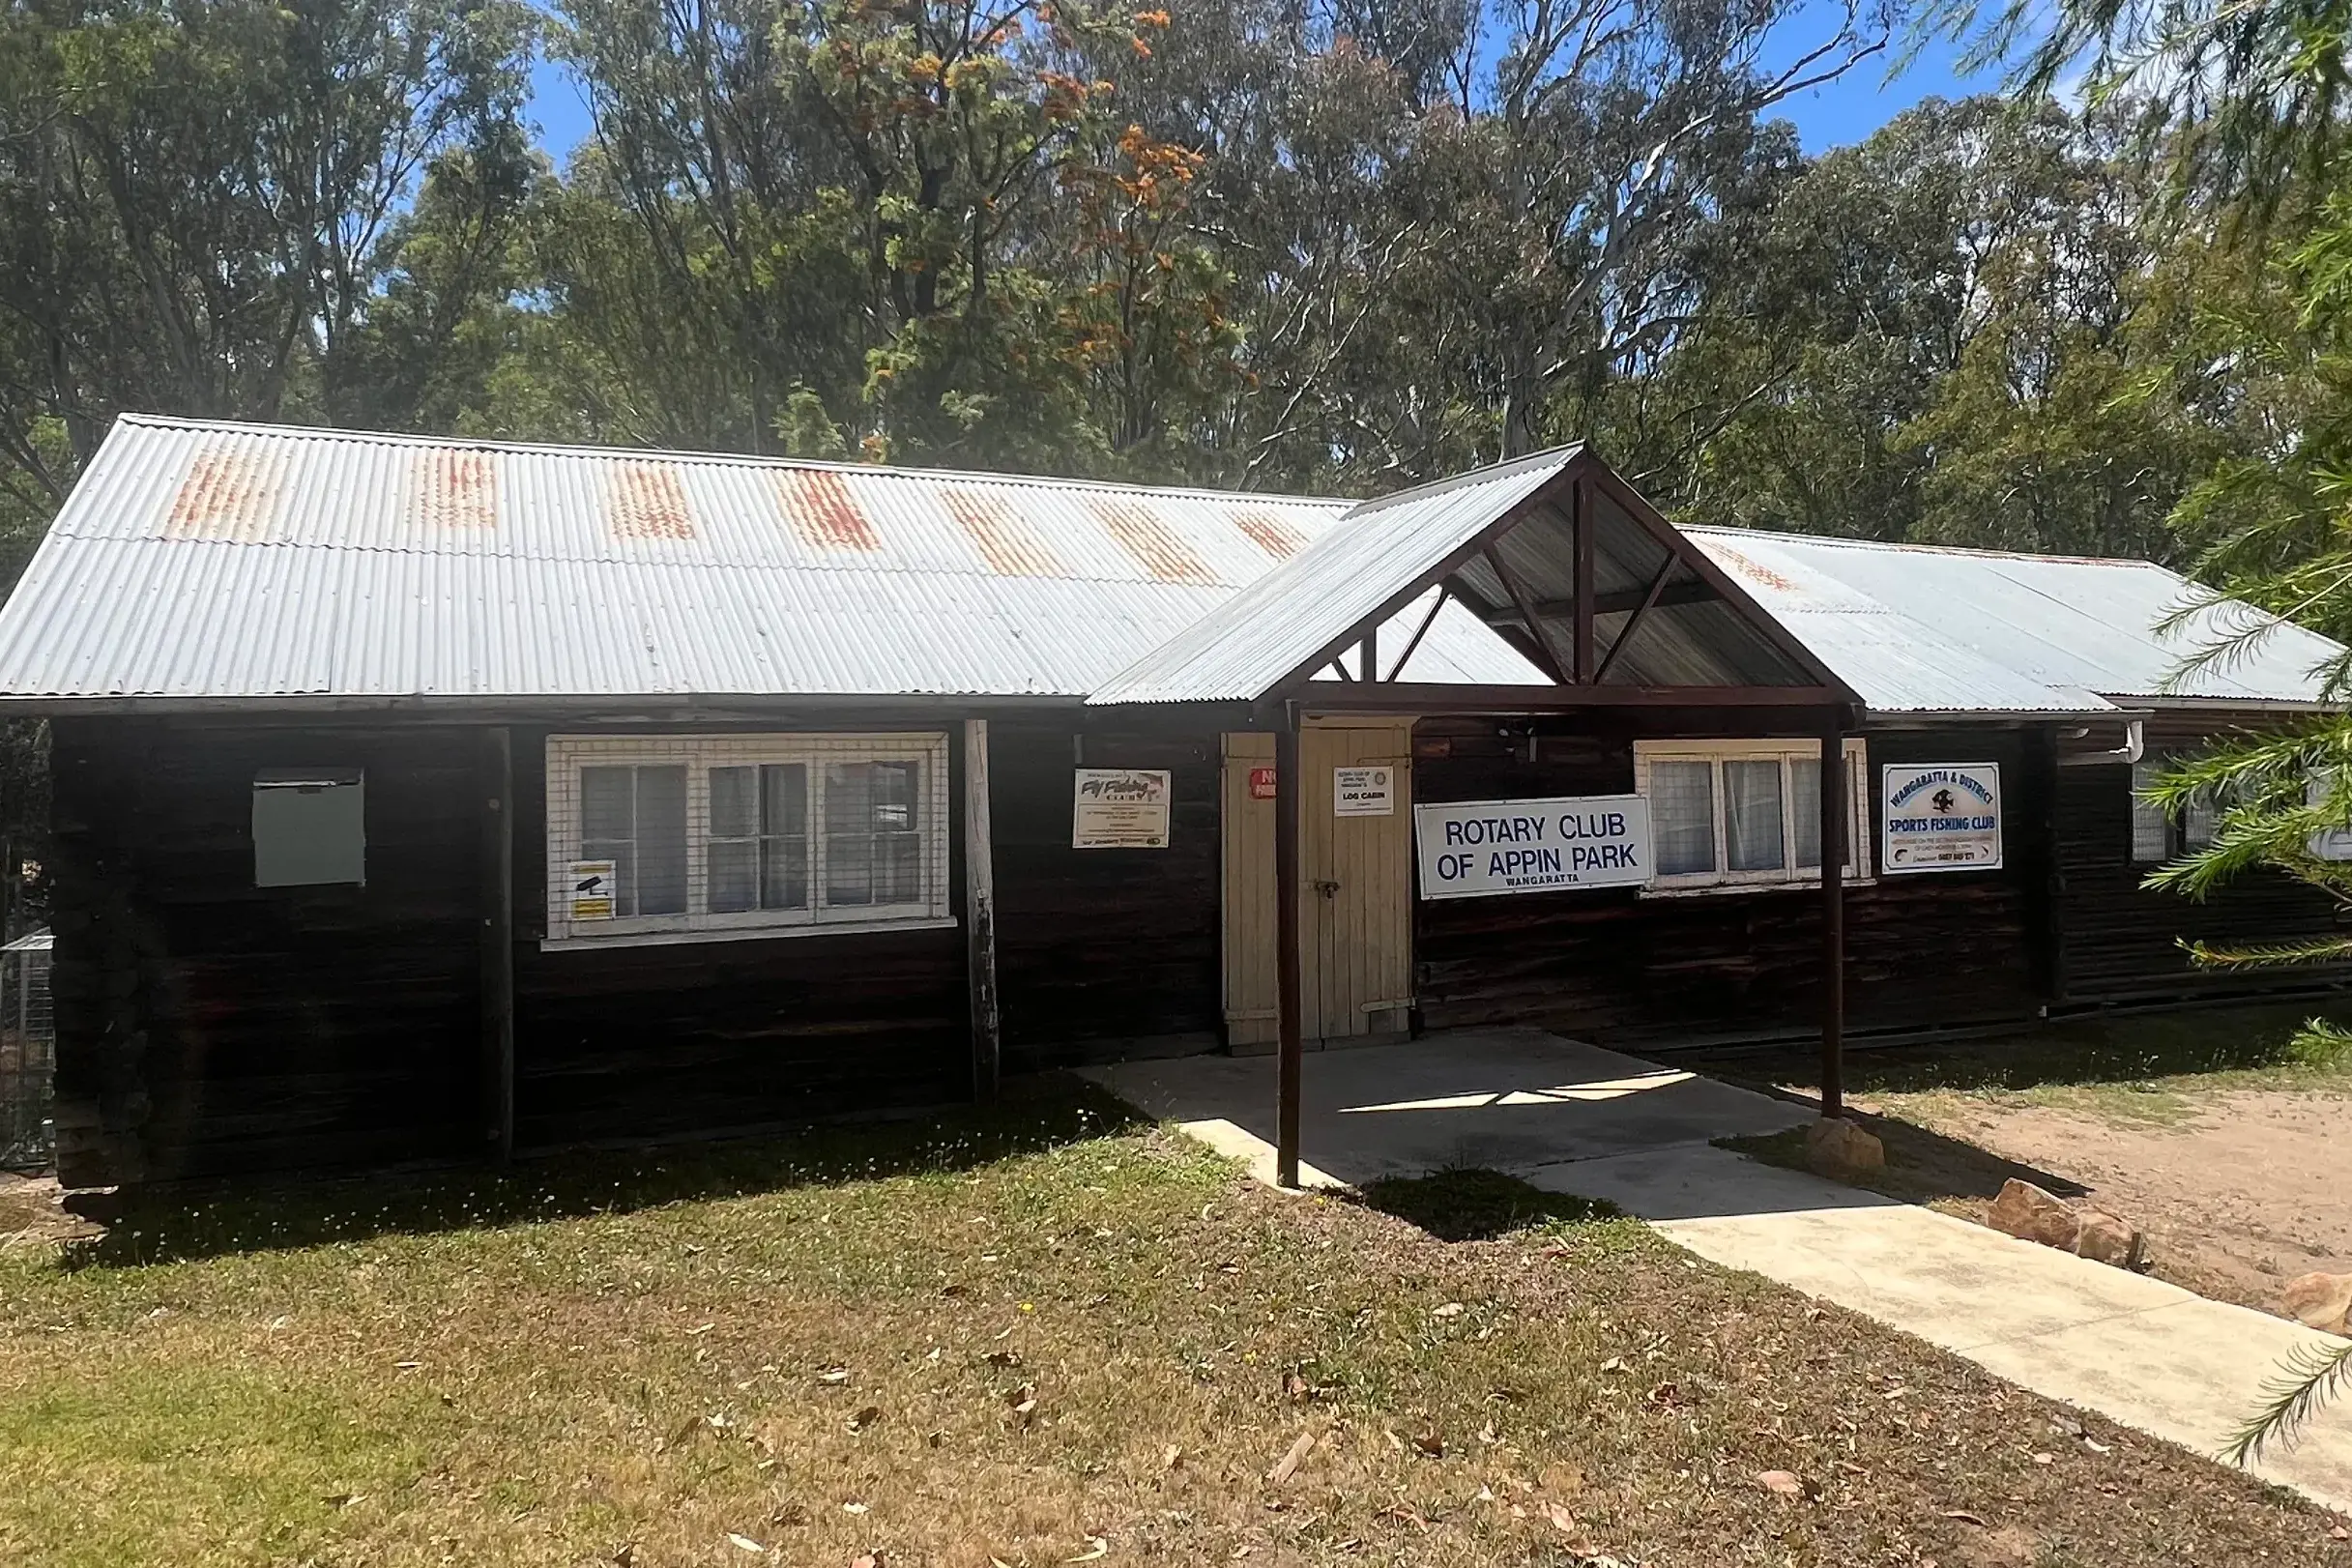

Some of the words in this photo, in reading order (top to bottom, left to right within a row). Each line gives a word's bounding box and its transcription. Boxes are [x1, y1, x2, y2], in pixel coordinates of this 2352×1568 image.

[1890, 770, 1949, 807] WANGARATTA
[1951, 771, 1958, 783] &
[1959, 773, 1993, 804] DISTRICT
[1445, 817, 1546, 846] ROTARY
[1558, 812, 1626, 840] CLUB
[1889, 818, 1928, 832] SPORTS
[1931, 817, 1969, 831] FISHING
[1972, 815, 1995, 829] CLUB
[1437, 854, 1474, 881] OF
[1488, 848, 1561, 877] APPIN
[1572, 843, 1639, 870] PARK
[1506, 874, 1580, 886] WANGARATTA
